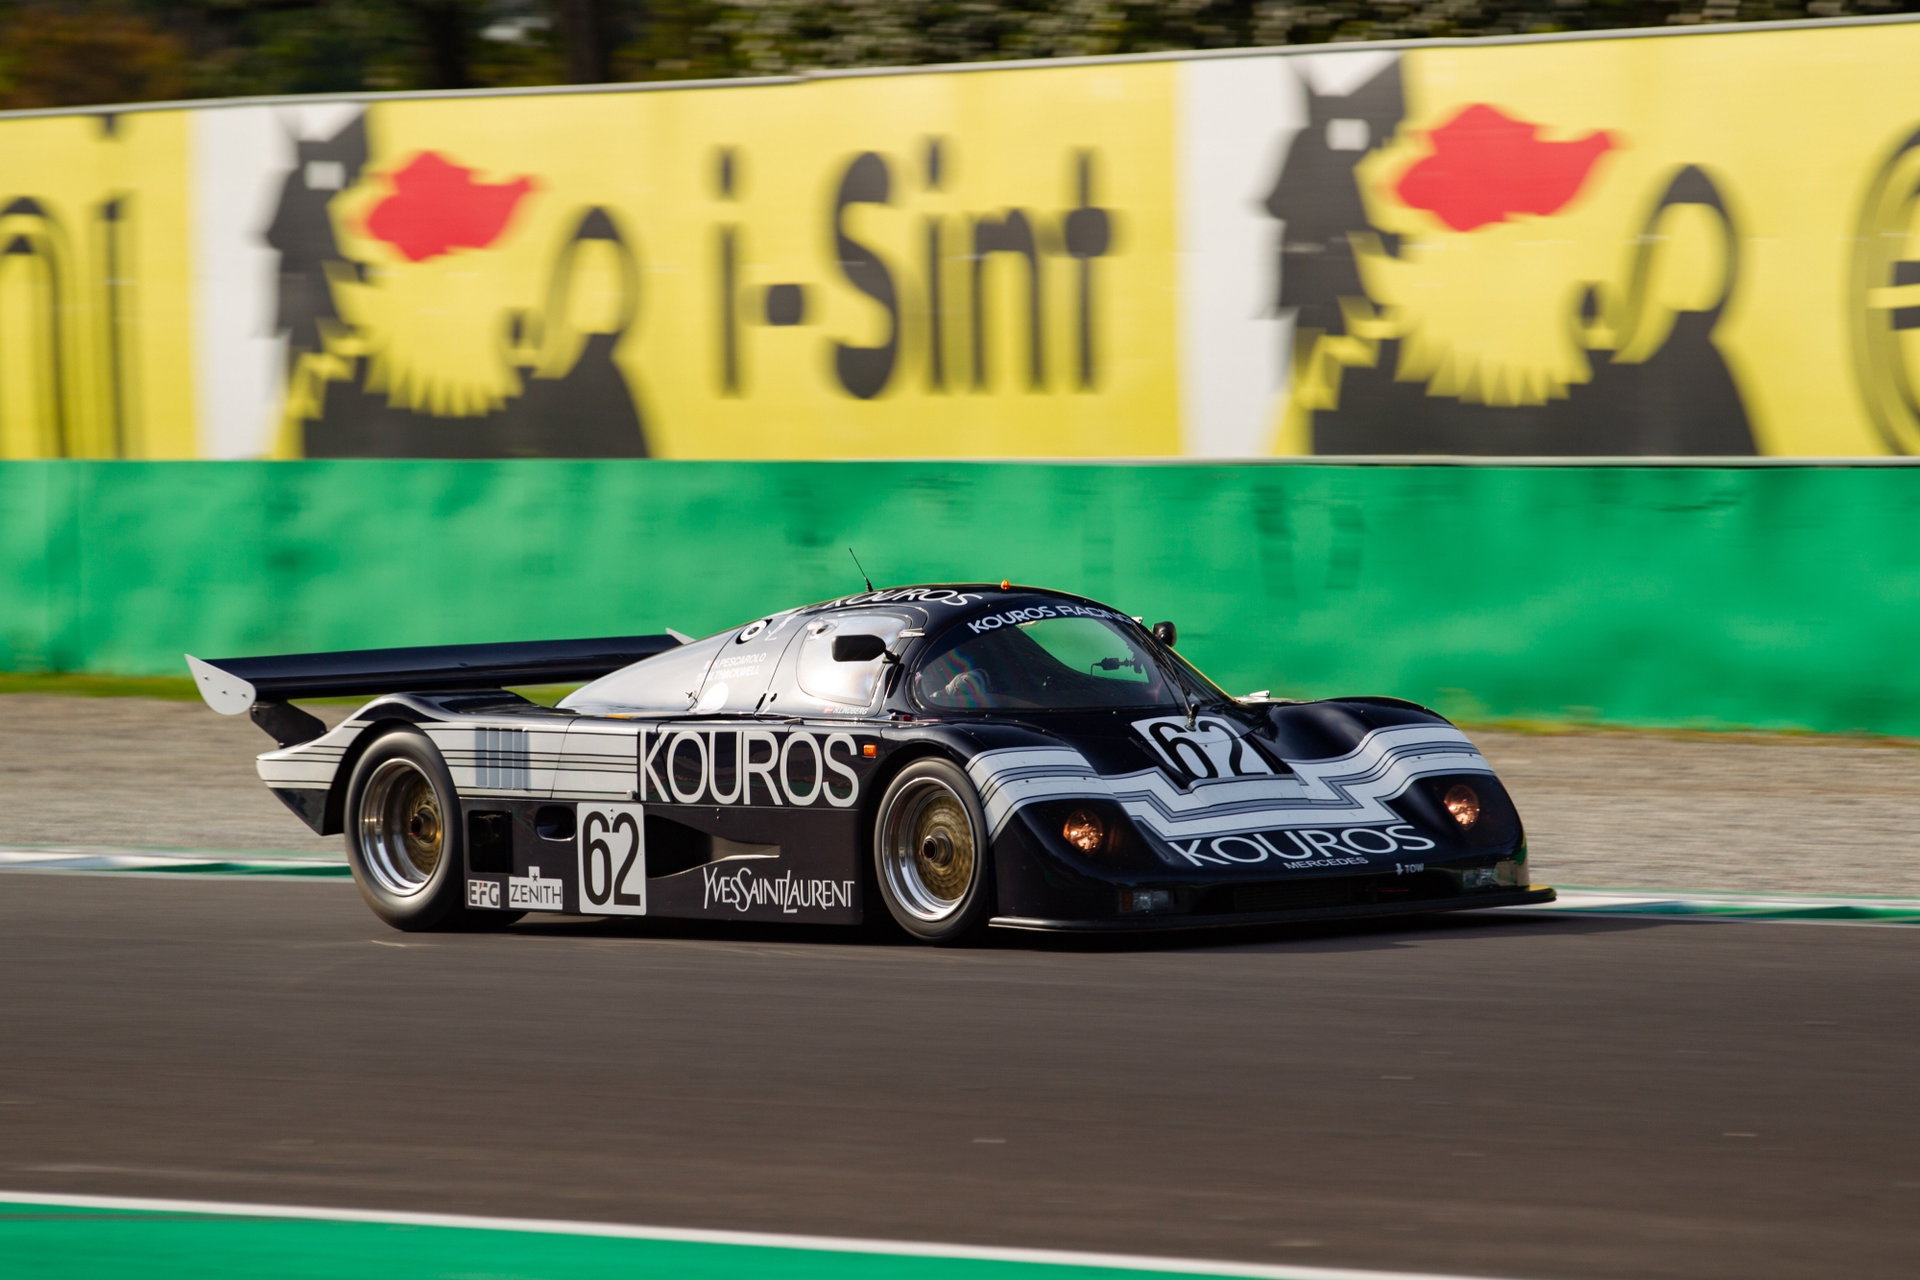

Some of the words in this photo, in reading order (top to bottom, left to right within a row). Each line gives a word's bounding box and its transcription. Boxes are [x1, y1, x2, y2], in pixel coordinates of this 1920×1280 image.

[708, 132, 1128, 399] i-Sint
[822, 588, 983, 609] KOUROS
[967, 605, 1056, 634] KOUROS
[1148, 718, 1267, 779] 62
[639, 728, 860, 808] KOUROS
[583, 811, 641, 907] 62
[1168, 825, 1436, 867] KOUROS
[1283, 857, 1369, 869] MERCEDES
[1405, 863, 1425, 874] TOW
[469, 881, 500, 907] EFG
[510, 884, 563, 905] ZENITH
